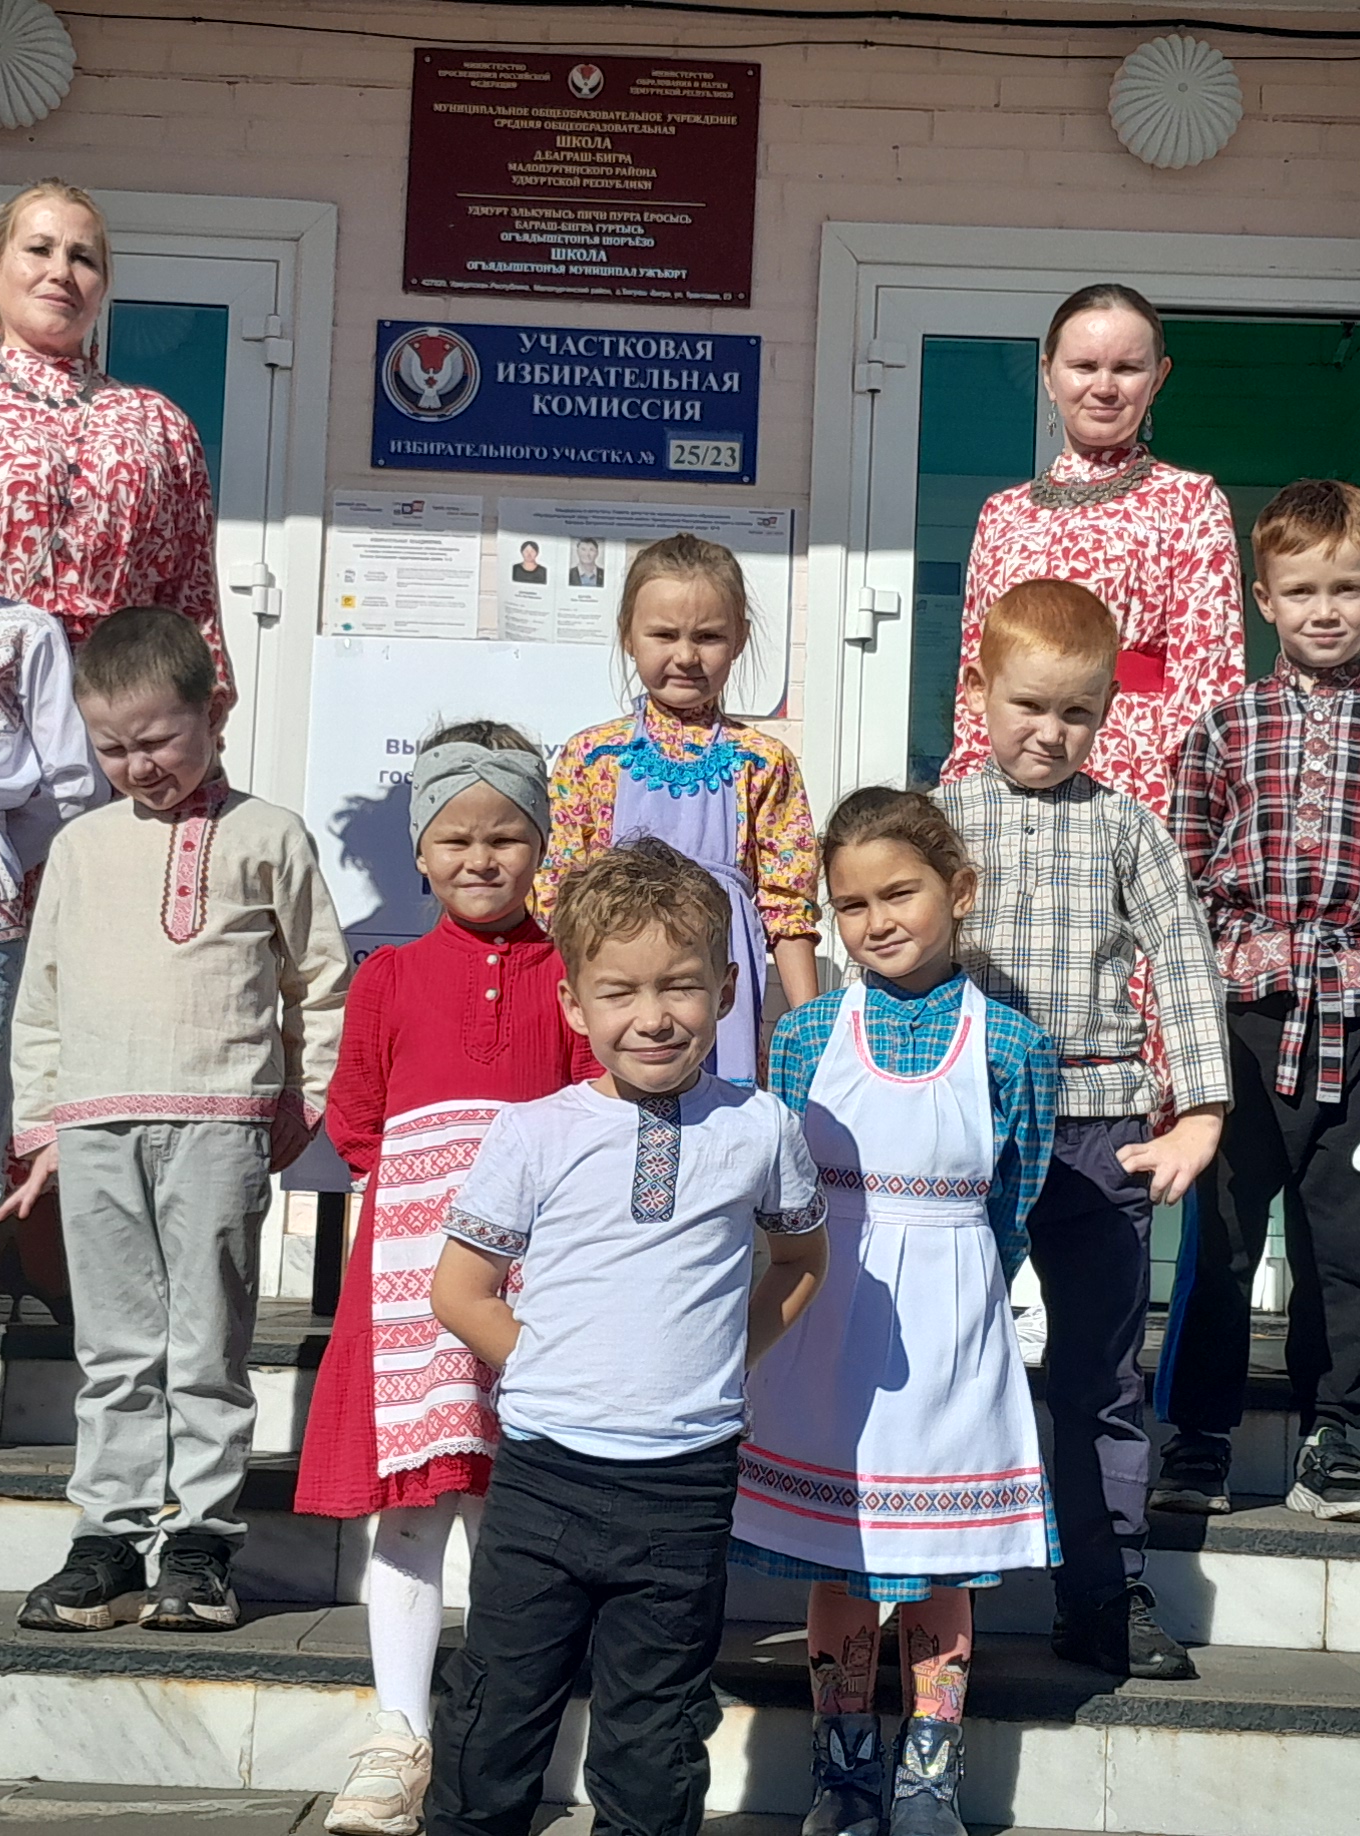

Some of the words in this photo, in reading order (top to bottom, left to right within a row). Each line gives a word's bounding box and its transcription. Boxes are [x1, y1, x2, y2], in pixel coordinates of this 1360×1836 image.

[433, 103, 530, 116] МУНИЦИПАЛЬНОЕ
[531, 107, 662, 122] ОБЩЕОБРАЗОВАТЕЛЬНОЕ
[667, 113, 738, 125] УЧРЕЖДЕНИЕ
[494, 119, 542, 129] СРЕДНЯЯ
[544, 121, 676, 135] ОБЩЕОБРАЗОВАТЕЛЬНАЯ
[556, 135, 612, 149] ШКОЛА
[508, 163, 614, 176] МАЛОПУРГИНСКОГО
[615, 166, 658, 178] РАЙОНА
[511, 175, 580, 187] УДМУРТСКОЙ
[583, 178, 652, 190] РЕСПУБЛИКИ
[468, 206, 509, 216] УДМУРТ
[577, 210, 607, 220] ПИЧИ
[609, 211, 641, 222] ПУРГА
[515, 220, 594, 232] БАГРАШ-БИГРА
[551, 248, 608, 262] ШКОЛА
[569, 265, 636, 277] МУНИЦИПАЛ
[519, 333, 713, 361] УЧАСТКОВАЯ
[497, 362, 740, 392] ИЗБИРАТЕЛЬНАЯ
[532, 394, 702, 421] КОМИССИЯ
[390, 439, 549, 460] ИЗБИРАТЕЛЬНОГО
[552, 447, 634, 464] УЧАСТКА
[637, 451, 655, 464] №
[673, 444, 737, 467] 25/23
